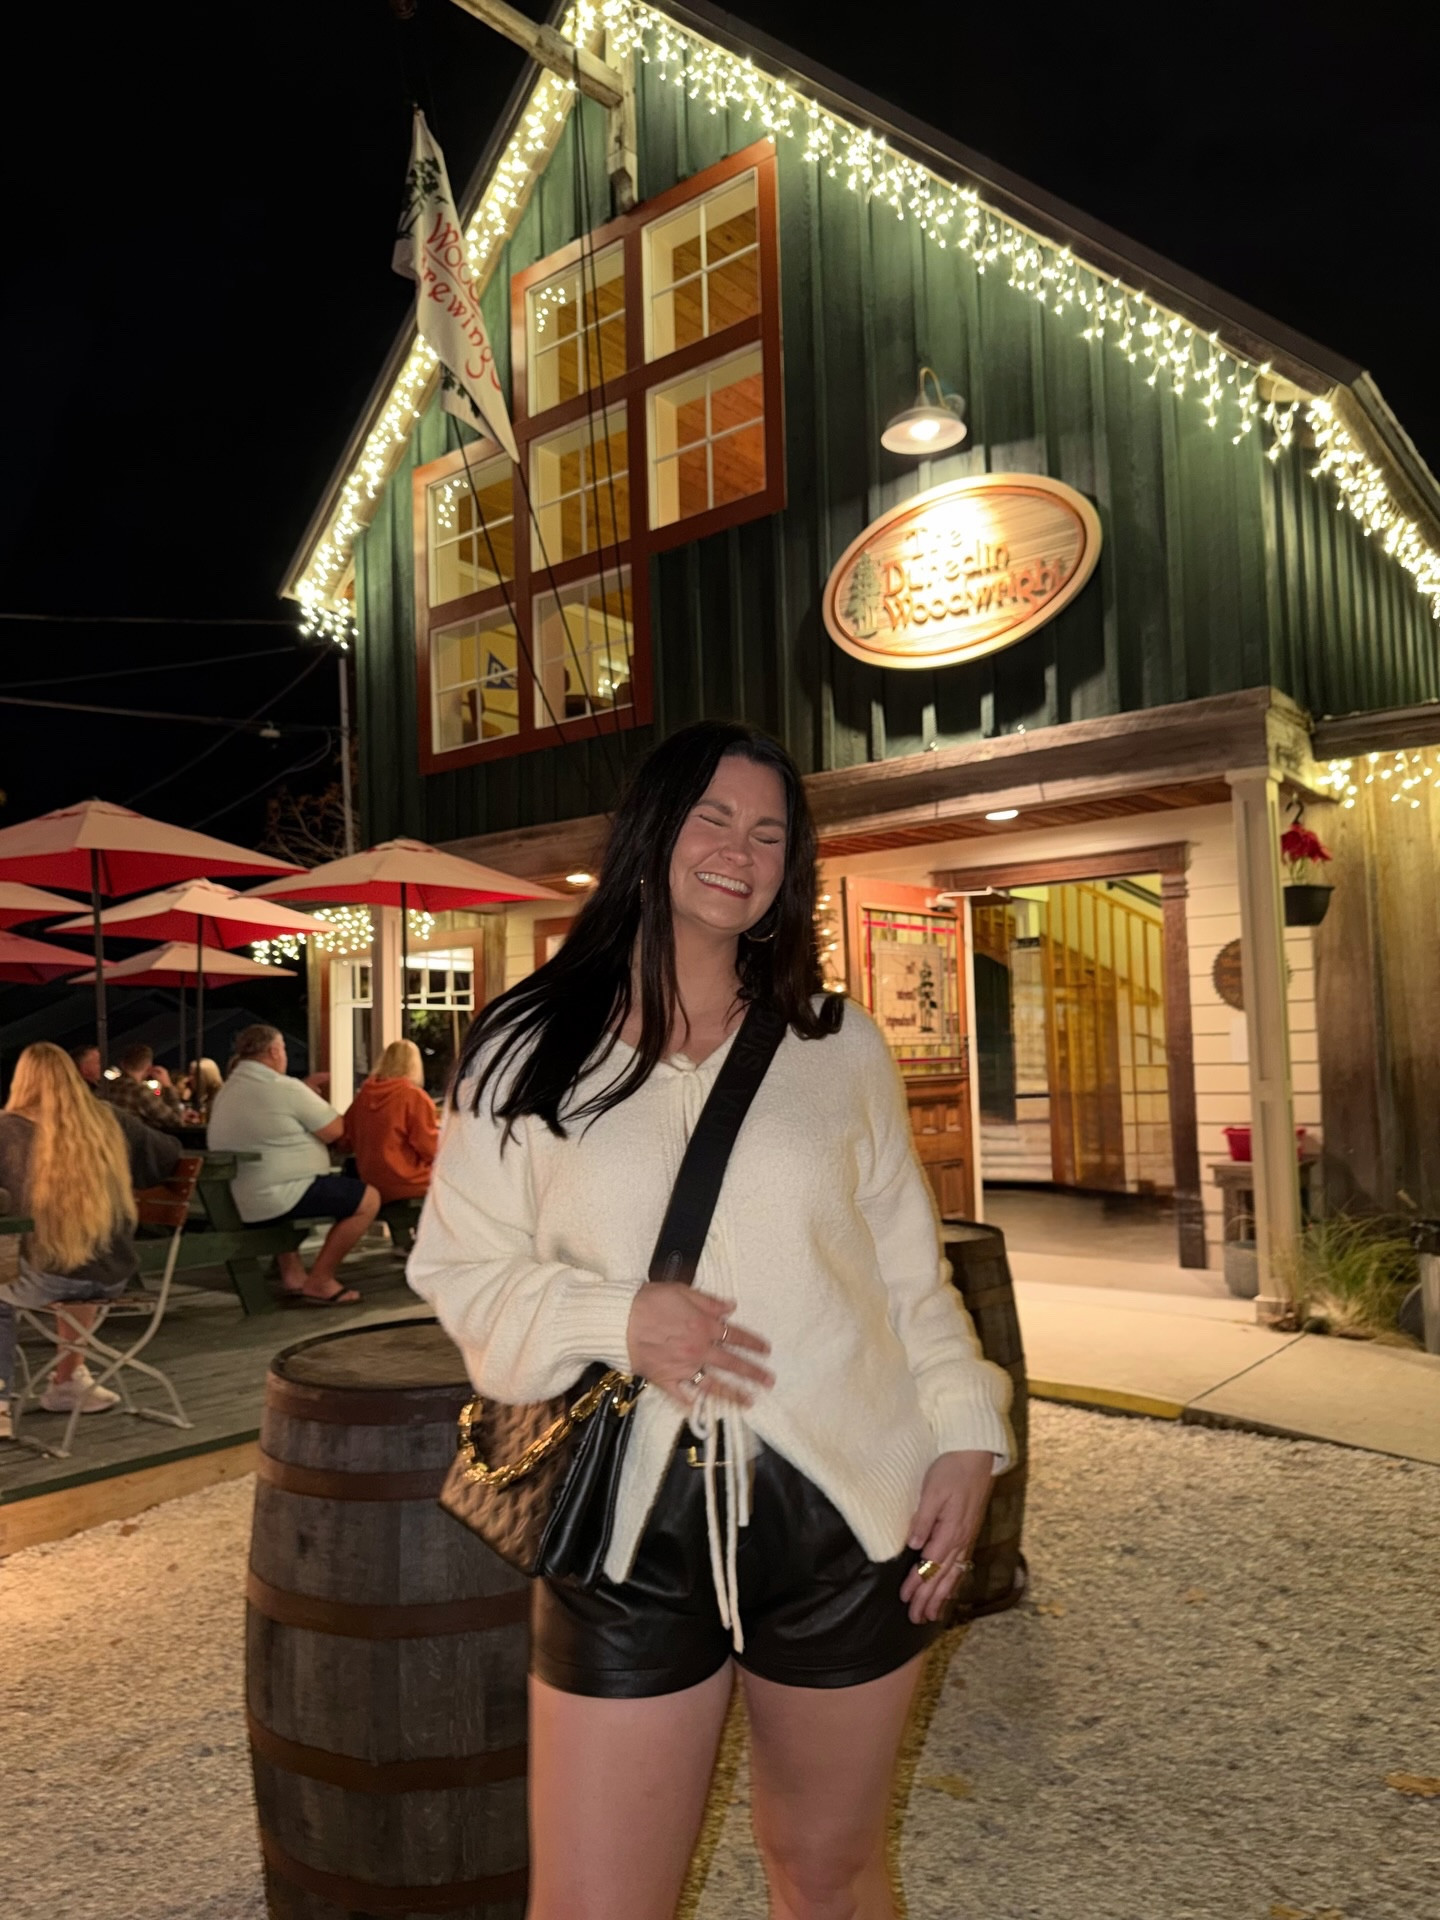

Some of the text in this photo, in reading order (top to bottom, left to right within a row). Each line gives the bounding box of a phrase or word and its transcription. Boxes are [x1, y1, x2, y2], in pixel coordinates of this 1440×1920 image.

[421, 256, 493, 380] rewing
[882, 538, 1010, 598] Duedin
[904, 526, 964, 560] Te
